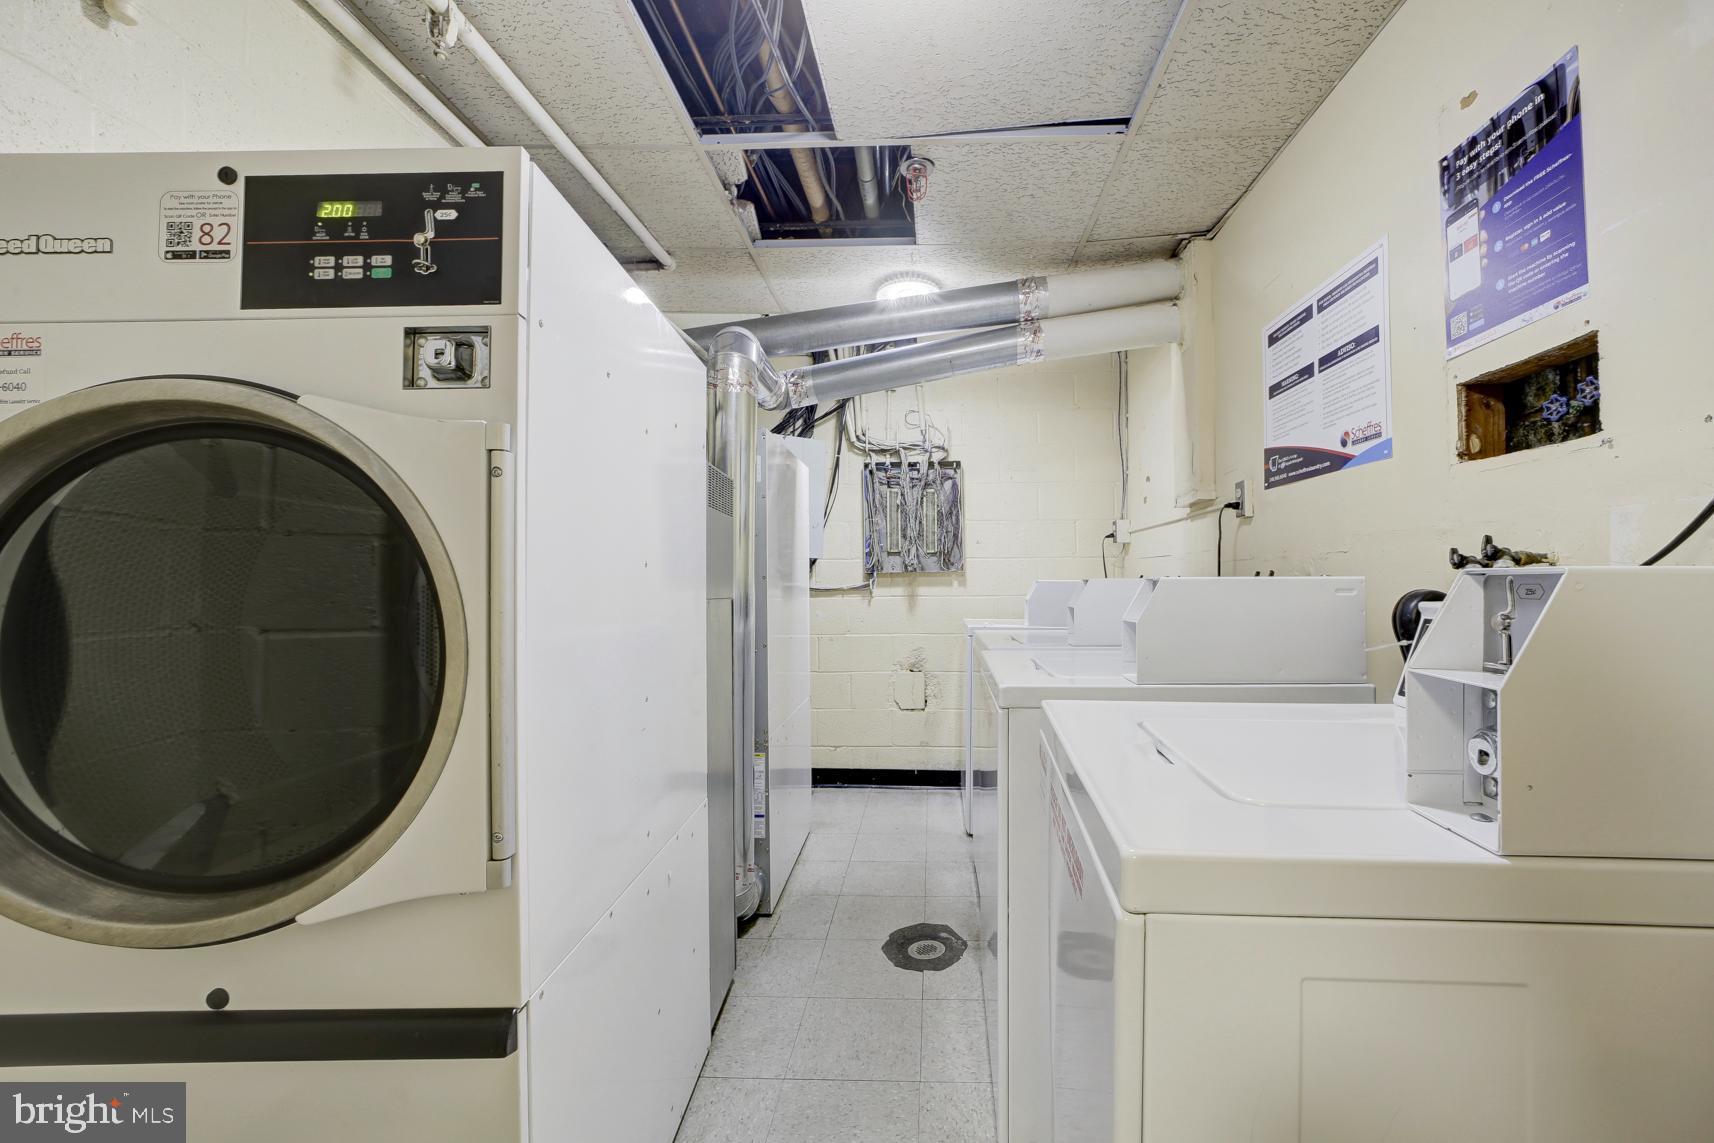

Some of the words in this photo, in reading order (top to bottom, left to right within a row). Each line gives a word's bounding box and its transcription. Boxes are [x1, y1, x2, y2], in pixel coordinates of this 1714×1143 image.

[1455, 155, 1468, 169] Pay
[1469, 140, 1486, 158] with
[1487, 125, 1505, 145] your
[1506, 102, 1534, 130] phone
[1534, 93, 1545, 105] in
[1461, 160, 1478, 177] easy
[198, 222, 232, 246] 82
[1351, 421, 1382, 440] Scheffres
